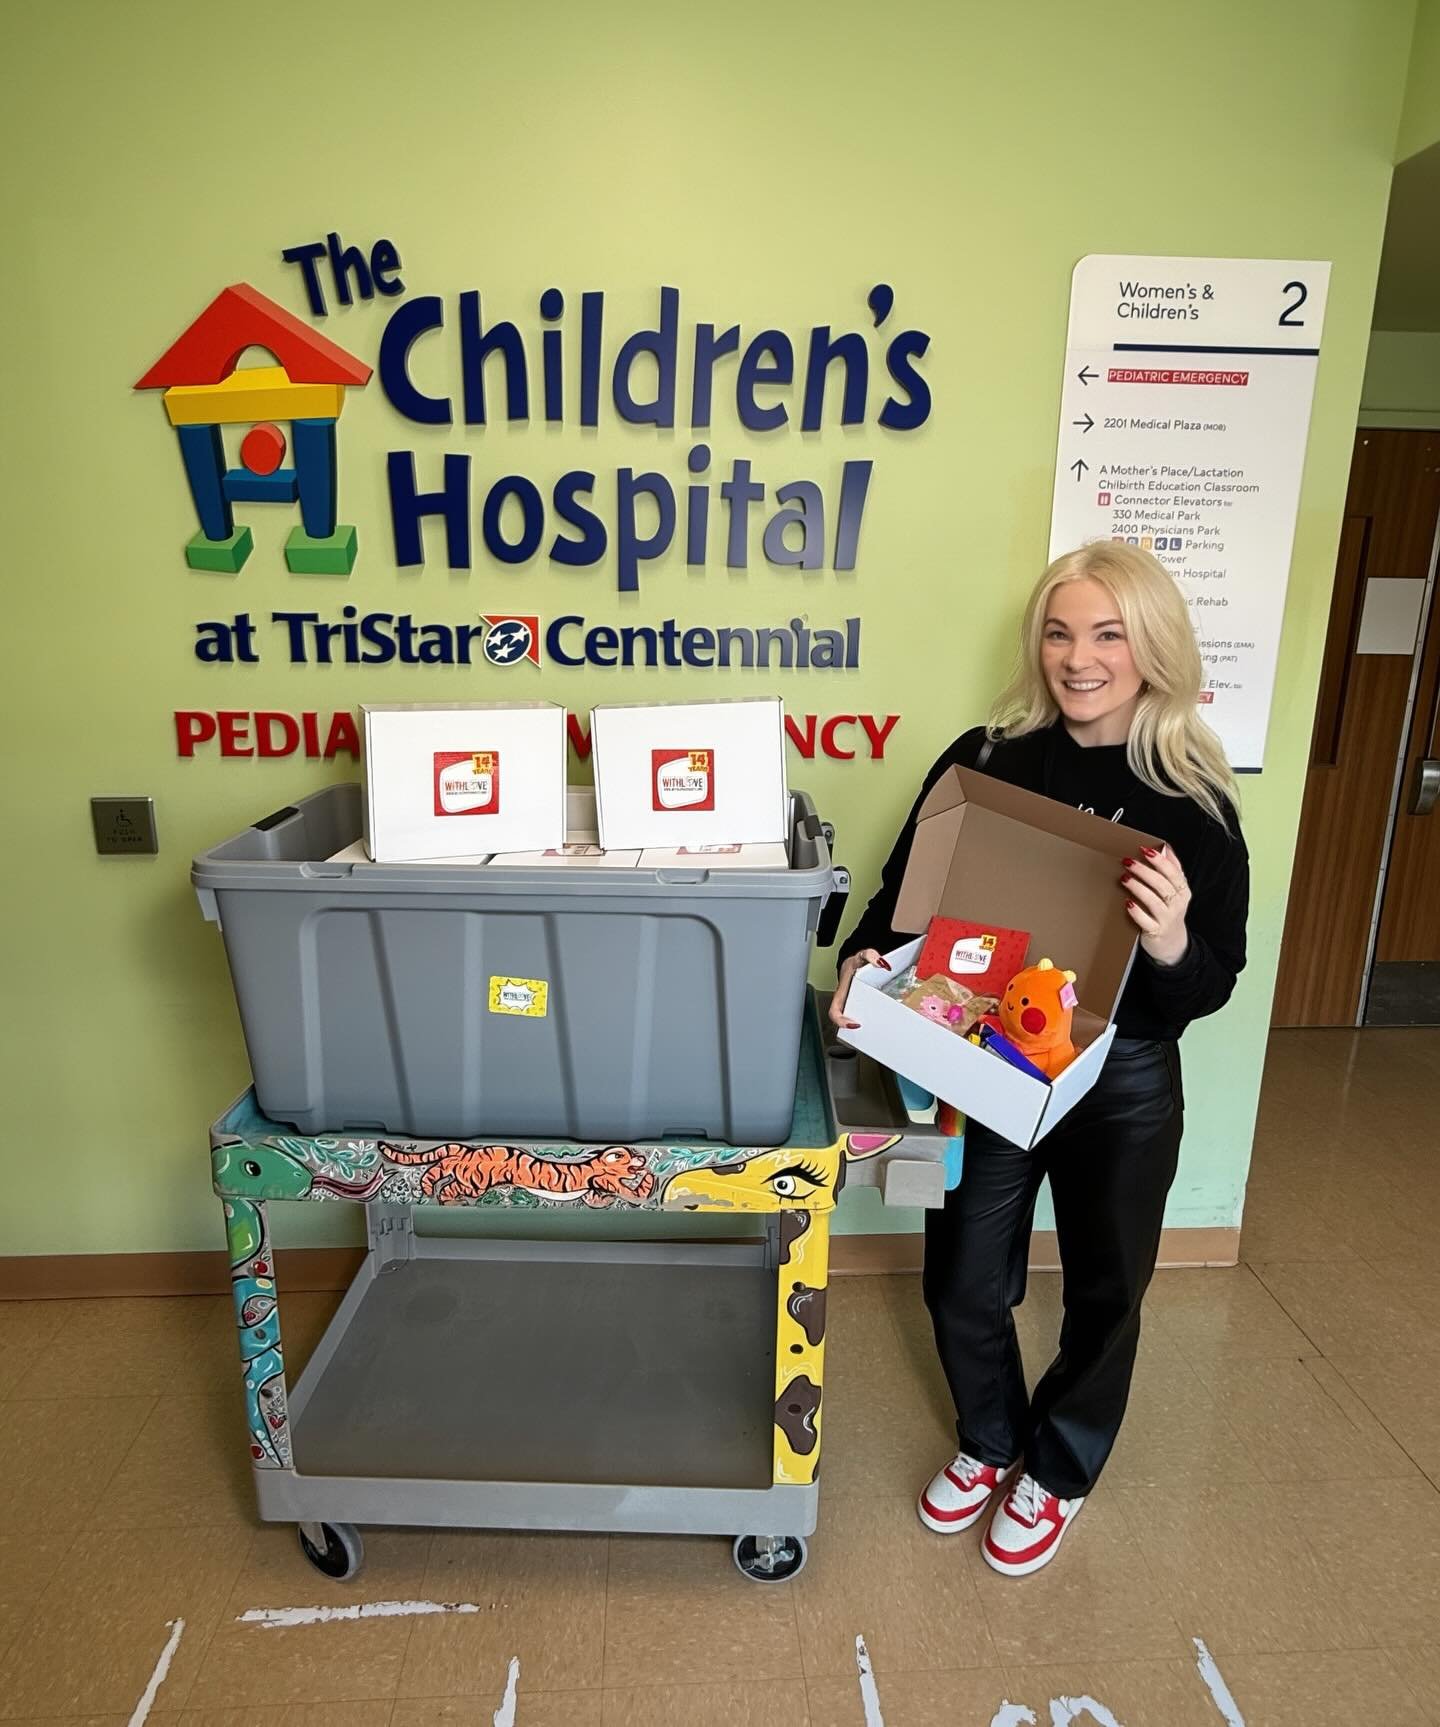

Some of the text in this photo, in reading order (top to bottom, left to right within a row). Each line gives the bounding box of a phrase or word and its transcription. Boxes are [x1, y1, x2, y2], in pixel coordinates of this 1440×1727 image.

[283, 232, 404, 317] The
[1119, 281, 1215, 300] Women's &
[1278, 280, 1308, 327] 2
[1116, 302, 1200, 320] Children's
[379, 284, 931, 432] Children's
[1108, 370, 1247, 384] PEDIATRIC EMERGENCY
[1103, 418, 1127, 429] 2201
[1130, 419, 1171, 431] Medical
[1174, 420, 1201, 431] Plaza
[1099, 465, 1244, 478] A Mother's Place/Lactation
[1098, 480, 1259, 492] Chilbirth Education Classroom
[1114, 495, 1171, 505] Connector
[1173, 496, 1222, 507] Elevators
[387, 444, 873, 592] Hospital
[1112, 509, 1200, 520] 330 Medical Park
[1111, 524, 1221, 537] 2400 Physicians Park
[1185, 539, 1225, 552] Parking
[1183, 569, 1227, 580] Hospital
[1196, 597, 1229, 607] Rehab
[195, 605, 861, 668] at TriStar Centennial
[1209, 680, 1232, 689] Elev.
[174, 711, 361, 760] PEDIA
[690, 753, 706, 766] 14
